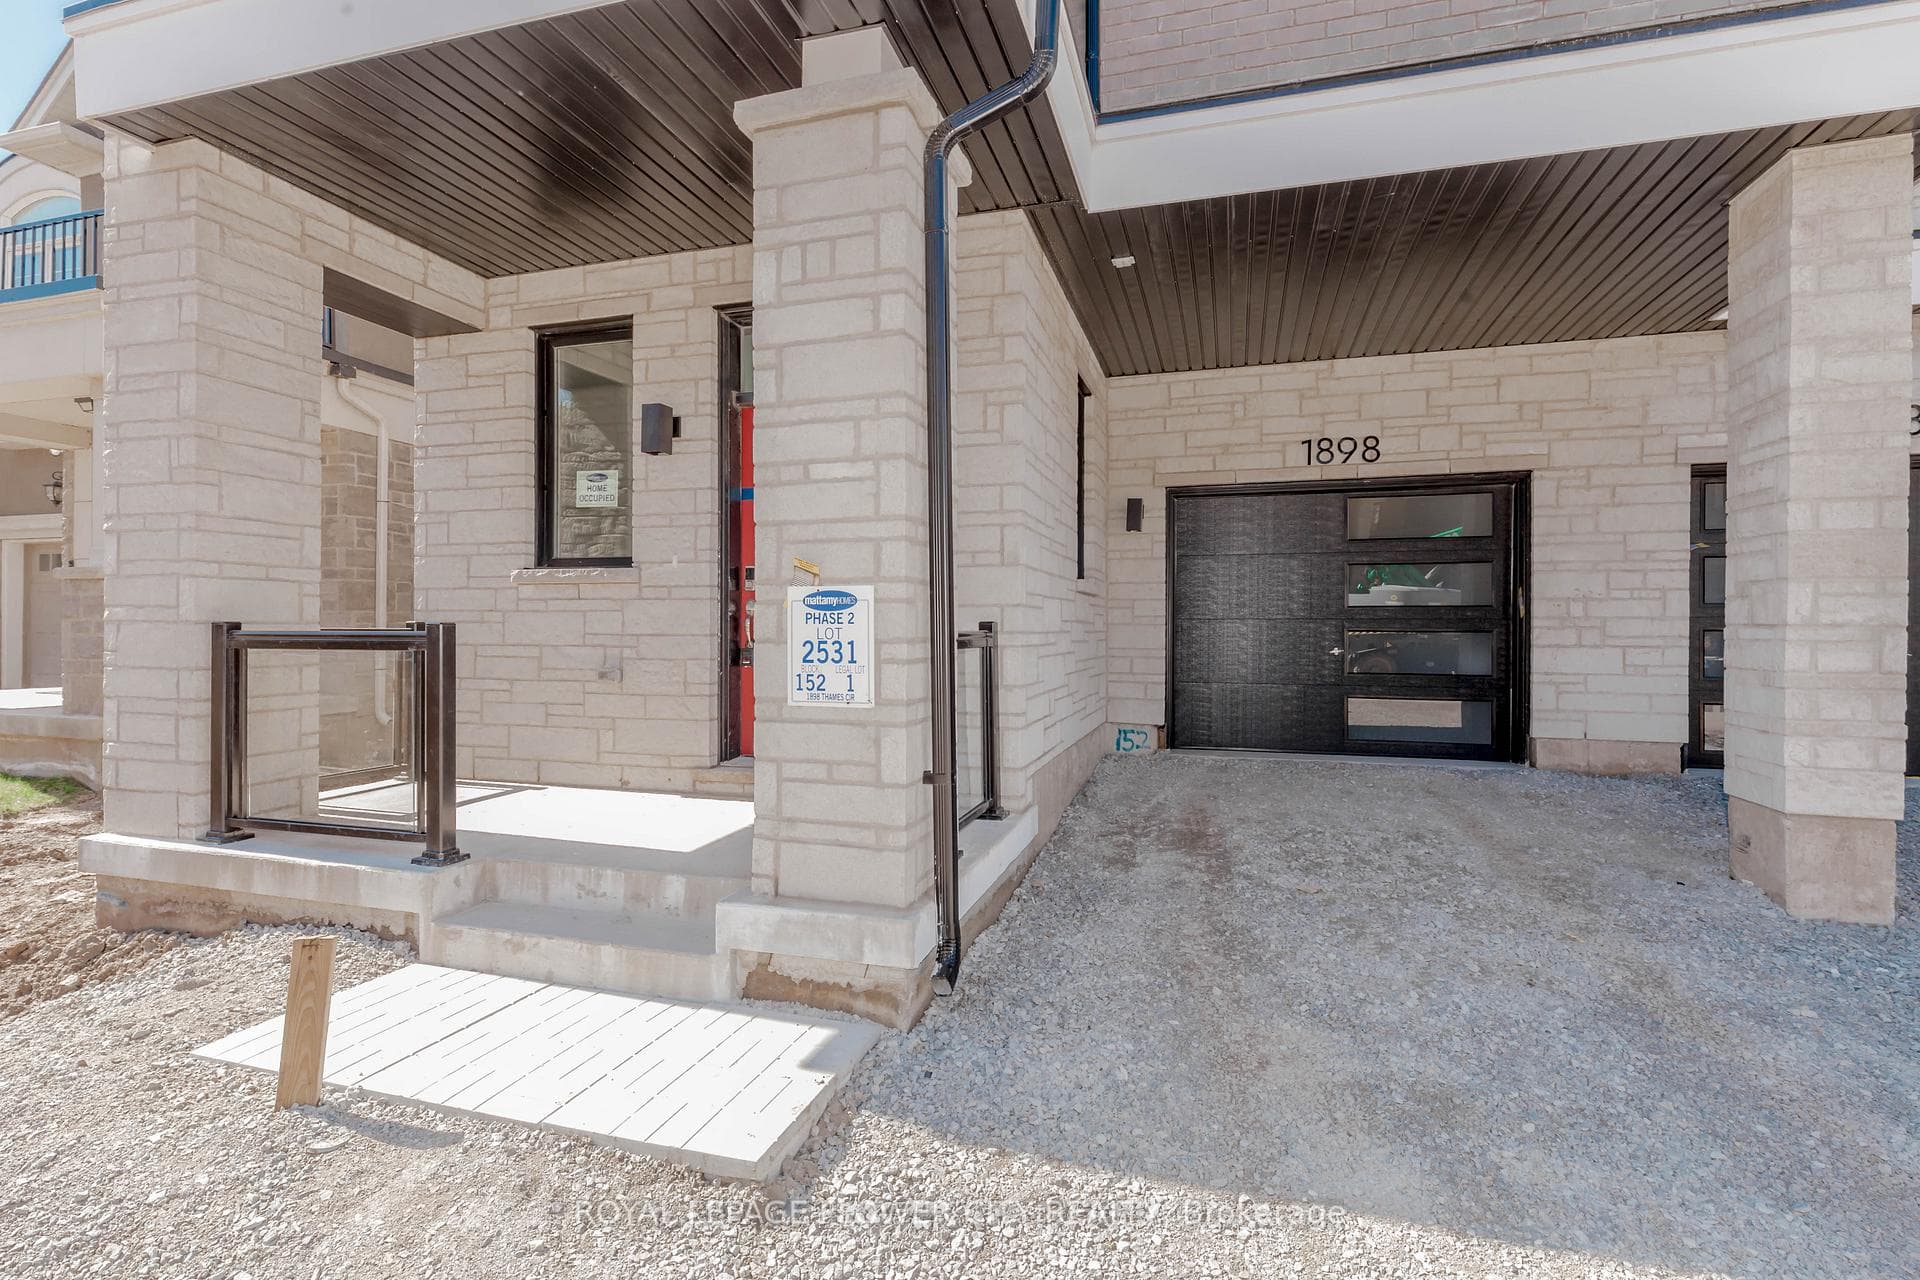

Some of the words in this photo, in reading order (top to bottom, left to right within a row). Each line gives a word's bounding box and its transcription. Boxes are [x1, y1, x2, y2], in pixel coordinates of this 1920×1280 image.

[1301, 435, 1380, 466] 1898
[587, 484, 608, 492] HOME
[579, 494, 615, 502] OCCUPIED
[805, 612, 844, 625] PHASE
[847, 612, 855, 625] 2
[816, 627, 843, 639] LOT
[802, 639, 857, 664] 2531
[796, 673, 826, 691] 152
[847, 674, 855, 692] 1
[821, 693, 844, 701] THAMES
[845, 693, 856, 701] CIR
[1115, 728, 1151, 752] 152
